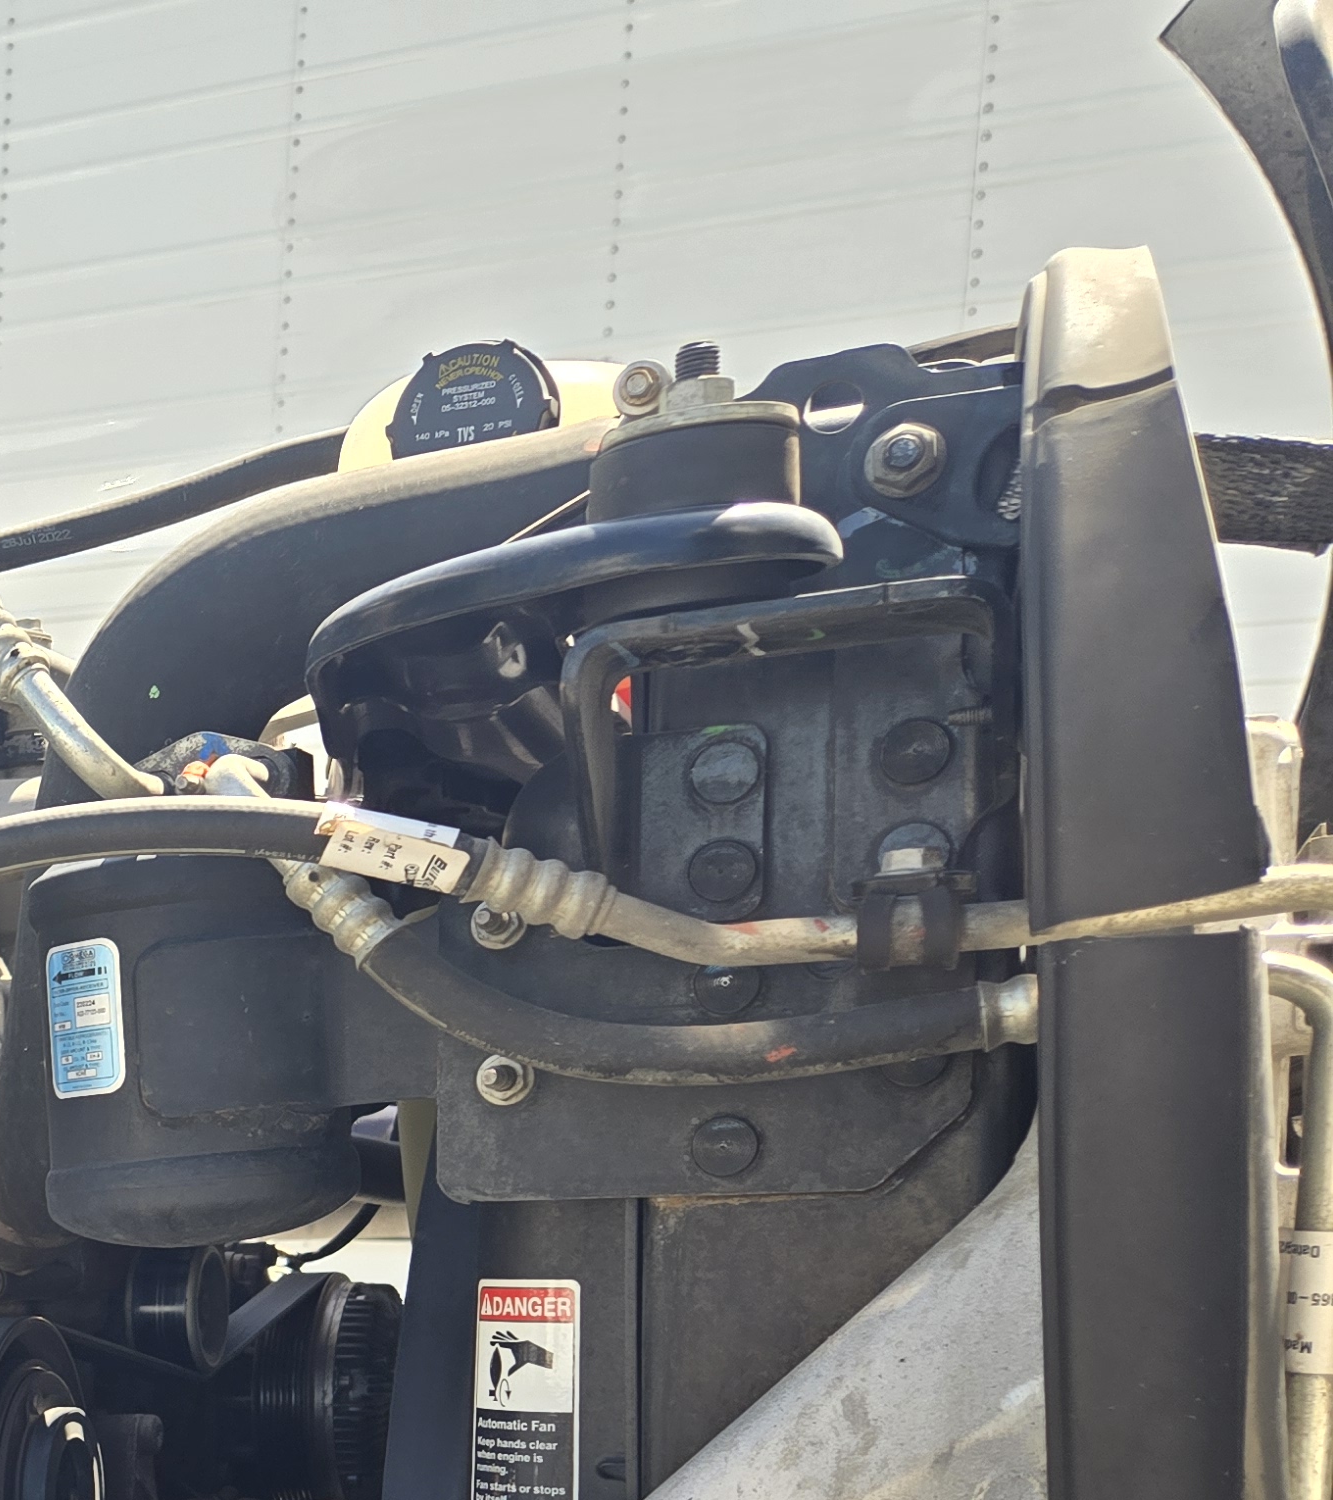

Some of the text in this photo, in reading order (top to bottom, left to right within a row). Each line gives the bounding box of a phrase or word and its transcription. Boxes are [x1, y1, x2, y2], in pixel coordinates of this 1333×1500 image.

[448, 353, 500, 371] CAUTION
[435, 369, 462, 390] NEVER
[441, 381, 496, 396] PRESSURIZED
[452, 391, 485, 403] SYSTEM
[482, 419, 512, 432] 20 PSI
[415, 432, 430, 442] 140
[457, 426, 475, 443] TVS
[492, 1296, 572, 1317] DANGER
[477, 1417, 556, 1432] Automatic Fan
[477, 1436, 558, 1450] Keep hands clear
[477, 1450, 544, 1463] when engine is
[476, 1463, 508, 1476] running.
[476, 1479, 566, 1497] Fan starts or stops
